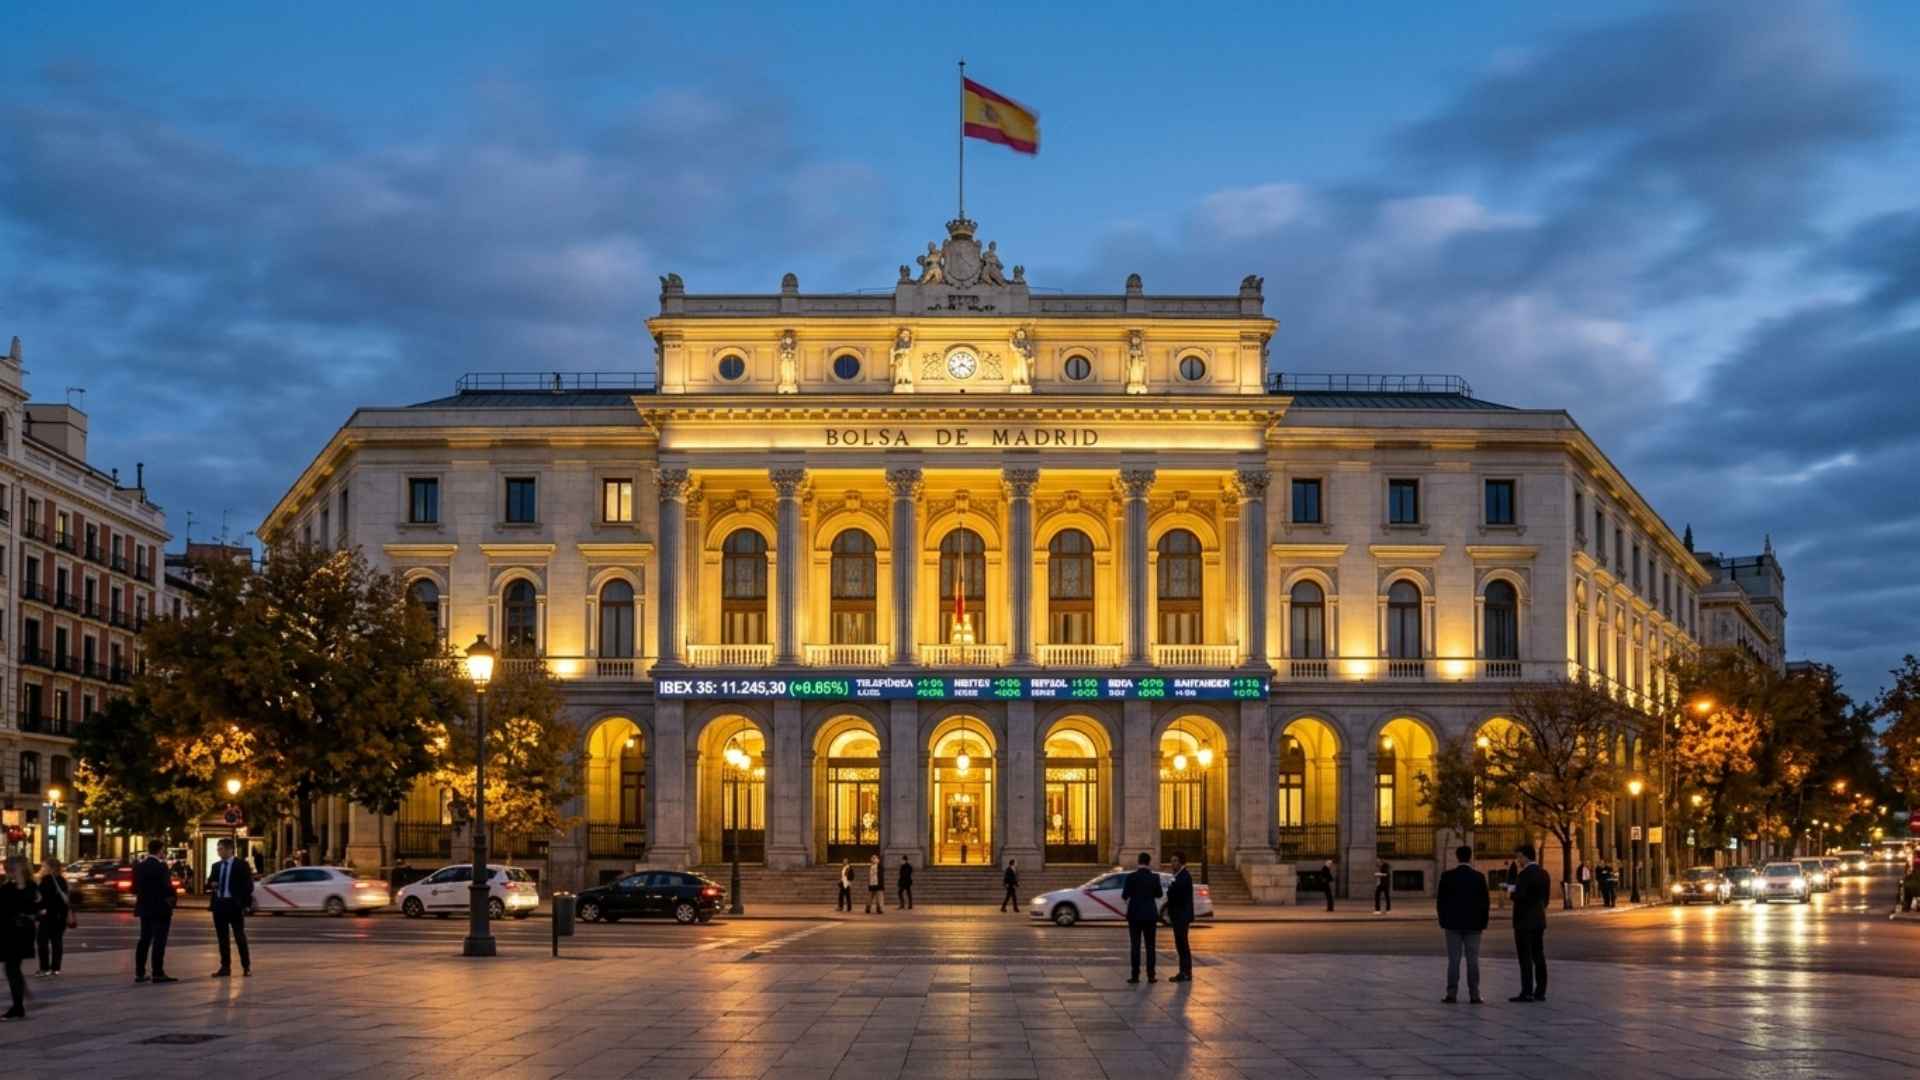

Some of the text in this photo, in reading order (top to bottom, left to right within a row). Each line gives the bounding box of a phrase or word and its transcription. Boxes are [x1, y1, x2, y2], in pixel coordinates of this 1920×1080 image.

[826, 428, 1099, 446] BOLSA DE MADRID
[659, 680, 693, 695] IBEX
[696, 680, 718, 695] 35:
[721, 680, 787, 696] 11.245,30
